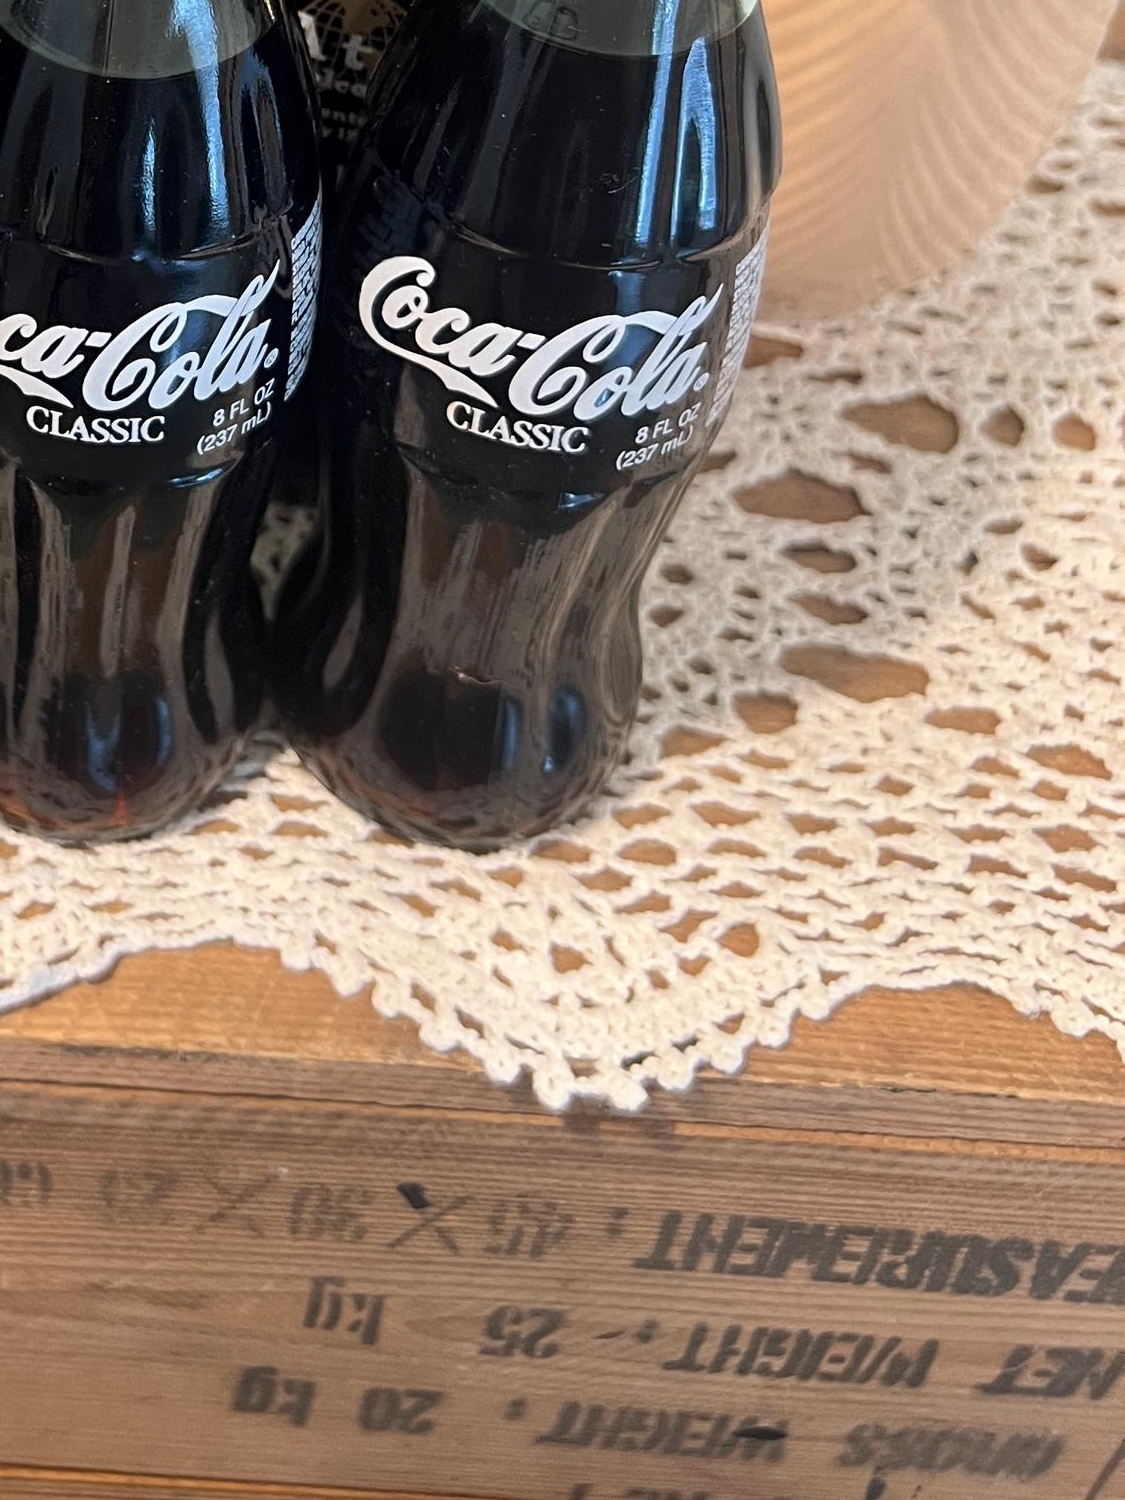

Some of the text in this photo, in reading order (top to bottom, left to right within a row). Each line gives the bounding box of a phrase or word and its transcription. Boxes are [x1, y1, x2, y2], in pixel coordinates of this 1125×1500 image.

[358, 255, 724, 422] Coca-Cola
[26, 405, 166, 444] CLASSIC
[196, 401, 271, 455] (237 mL)
[212, 377, 275, 427] 8 FL OZ
[446, 401, 590, 453] CLASSIC
[635, 402, 702, 444] 8 FL OZ
[616, 424, 694, 471] (237 mL)
[302, 1275, 387, 1346] kg
[479, 1304, 567, 1360] 25
[231, 1364, 318, 1428] kg
[974, 1343, 1125, 1400] NET
[357, 1386, 445, 1436] 20
